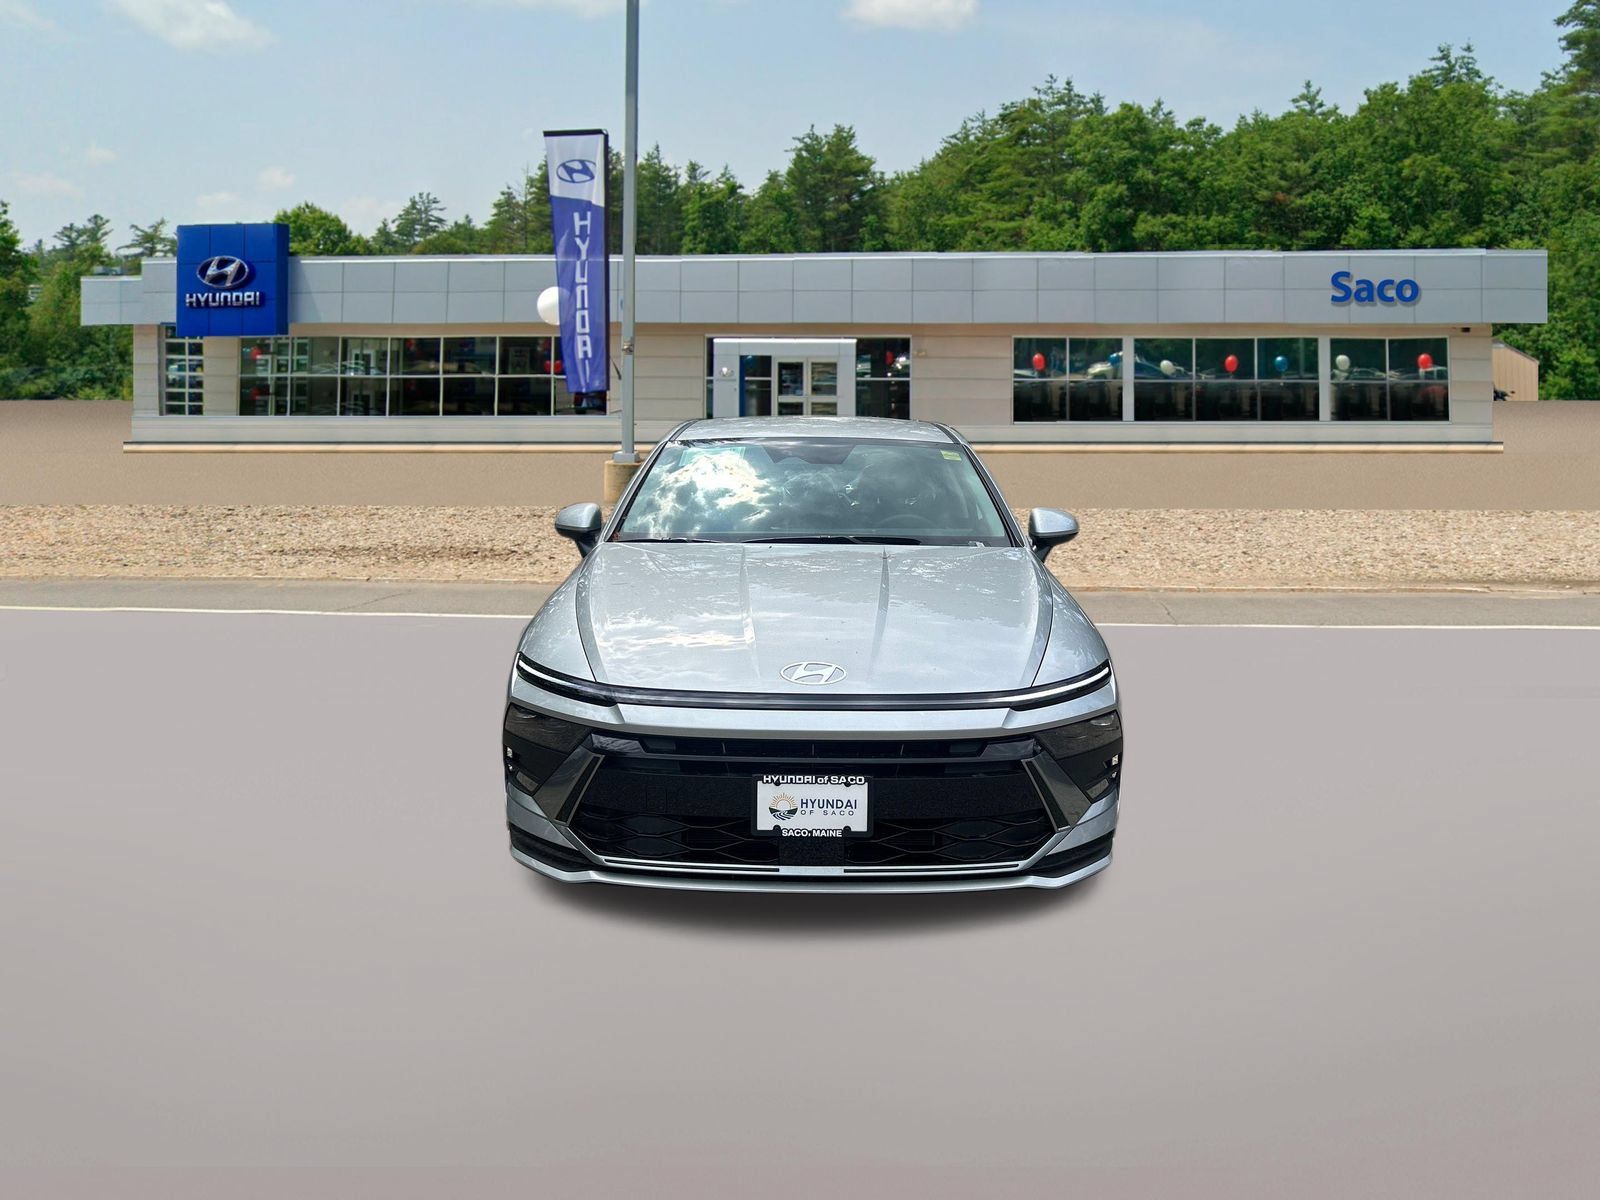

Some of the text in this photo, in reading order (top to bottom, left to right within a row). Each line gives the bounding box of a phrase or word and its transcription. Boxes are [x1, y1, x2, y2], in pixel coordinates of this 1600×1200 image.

[1331, 271, 1419, 303] Saco
[185, 291, 260, 307] HYUNDAI
[573, 211, 593, 383] HYUNDAI
[763, 775, 865, 784] HYUNDAI of SACO
[800, 799, 857, 809] HYUNDAI
[812, 829, 842, 837] MAINE
